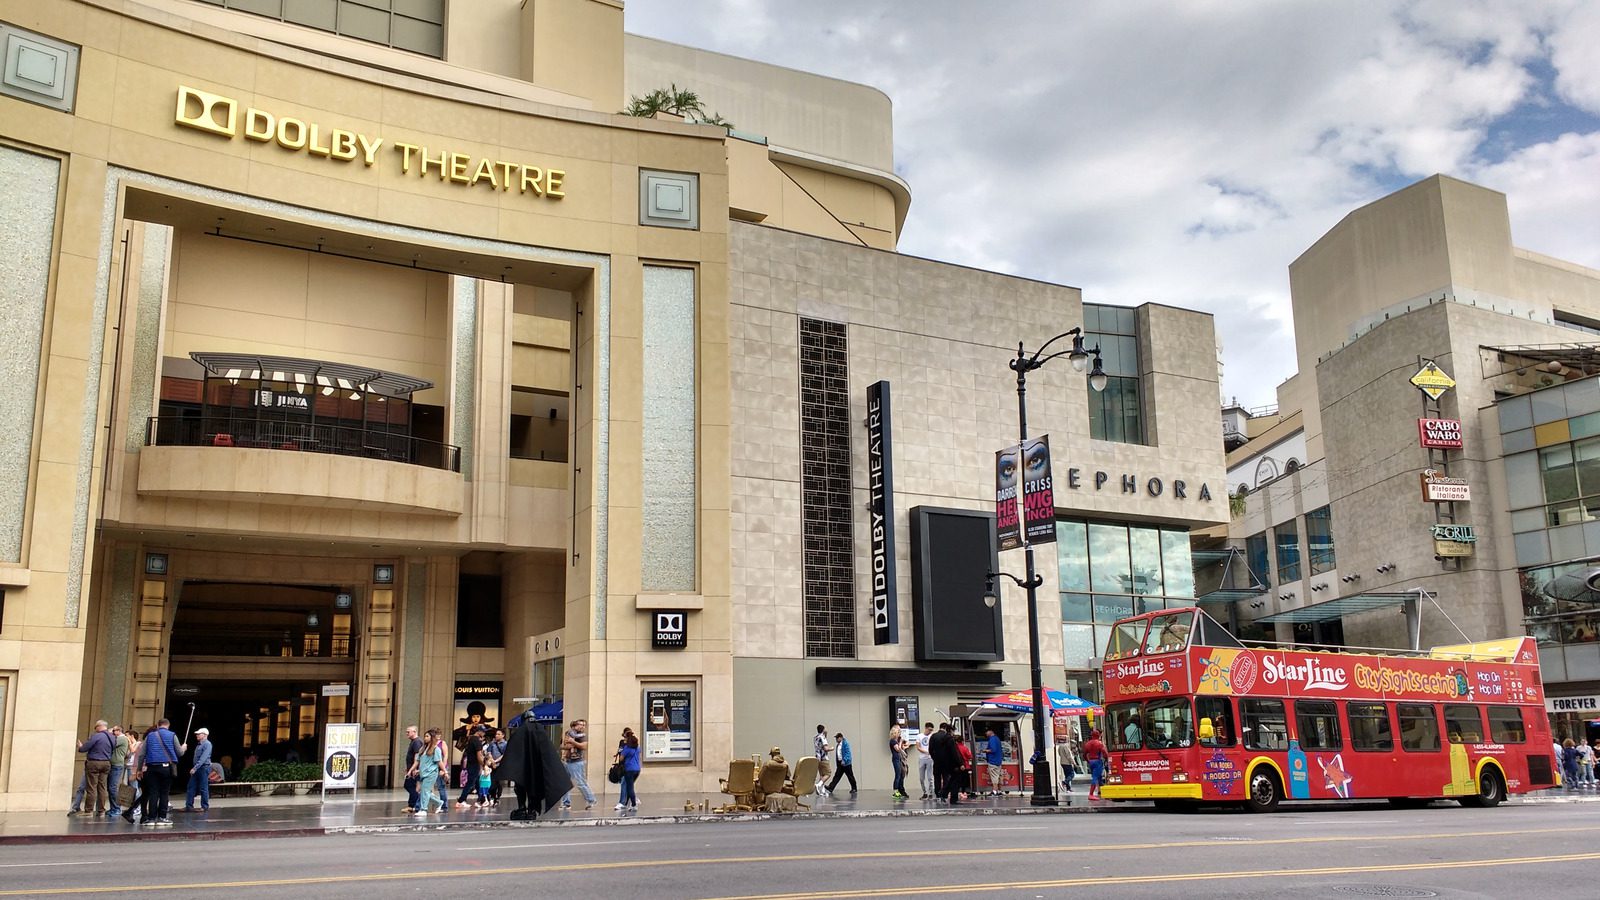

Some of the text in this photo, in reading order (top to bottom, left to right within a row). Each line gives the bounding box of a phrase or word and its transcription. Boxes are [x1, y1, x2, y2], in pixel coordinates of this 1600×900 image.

[245, 107, 567, 199] DOLBY THEATRE
[1415, 377, 1451, 385] california
[277, 395, 308, 407] JINYA
[1425, 421, 1460, 431] CABO
[1427, 430, 1461, 440] WABO
[1025, 476, 1051, 494] CRISS
[1069, 467, 1212, 502] EPHORA
[1432, 485, 1468, 493] Ristorante
[869, 398, 885, 591] DOLBY THEATRE
[997, 485, 1017, 501] DARRE
[1027, 506, 1054, 521] INCH
[1445, 527, 1473, 539] GRILL
[1095, 604, 1133, 615] SEPHORA
[535, 637, 560, 654] GRO
[1117, 660, 1166, 679] StarLine
[1262, 655, 1350, 691] StarLine
[1353, 663, 1458, 699] CitySightseeing
[1477, 671, 1500, 682] Hop On
[1479, 684, 1502, 695] Hop Off
[1553, 697, 1597, 710] FOREVER
[328, 732, 338, 745] IS
[332, 757, 351, 766] NEXT
[1123, 760, 1170, 768] 1-855-4LAHOPON
